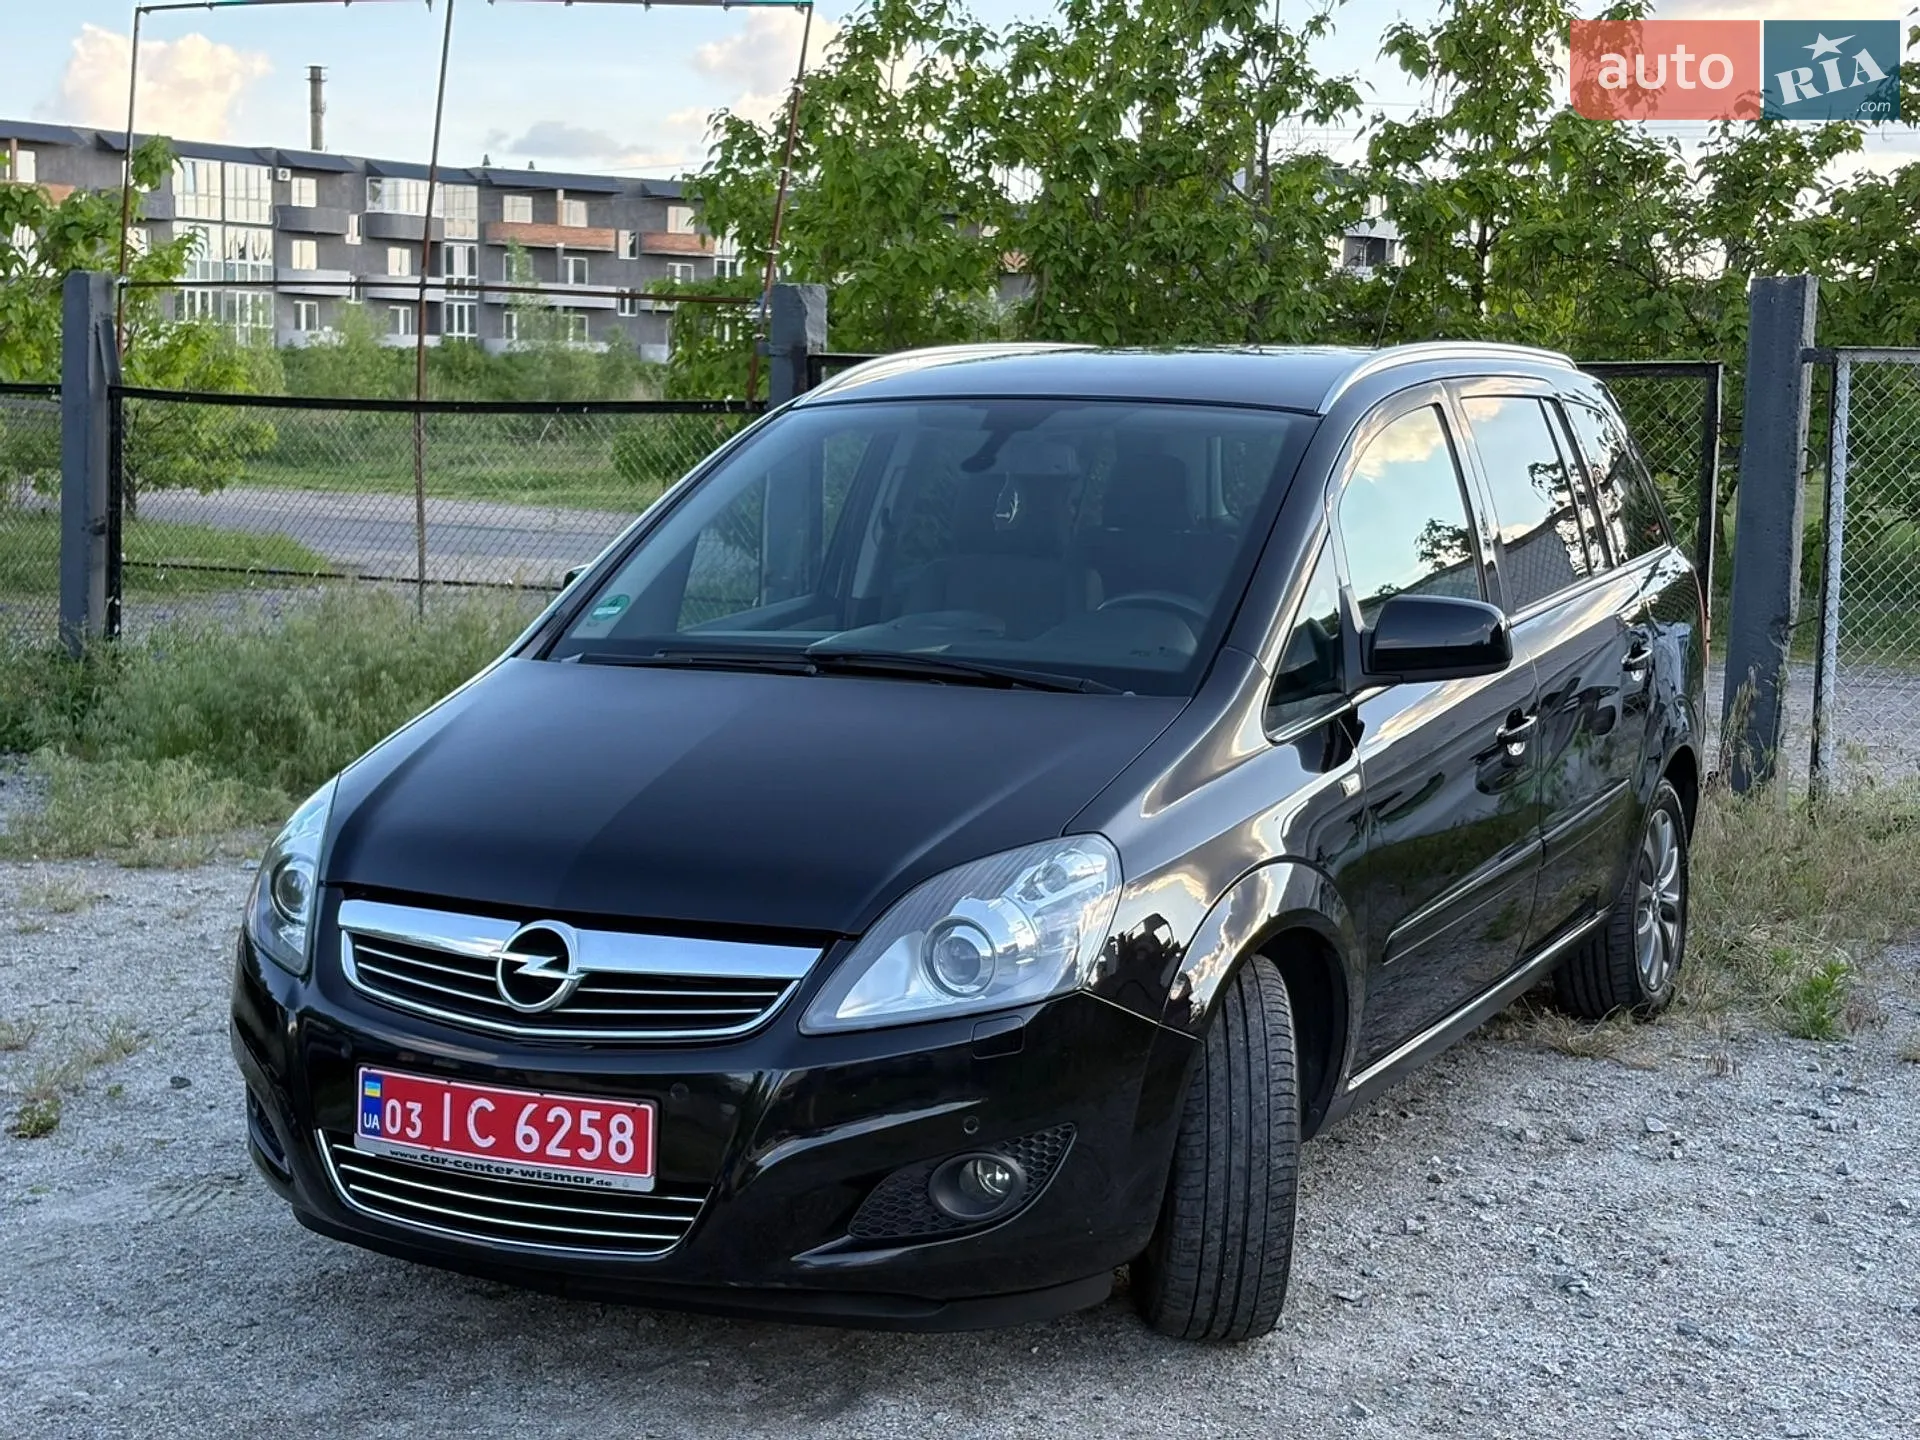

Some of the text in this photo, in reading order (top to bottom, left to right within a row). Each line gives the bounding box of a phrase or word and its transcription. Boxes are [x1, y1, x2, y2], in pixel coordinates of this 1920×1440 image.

[363, 1111, 380, 1130] UA
[385, 1098, 422, 1139] 03
[515, 1103, 634, 1164] 6258
[389, 1149, 612, 1187] www.car-center-wismar.de
